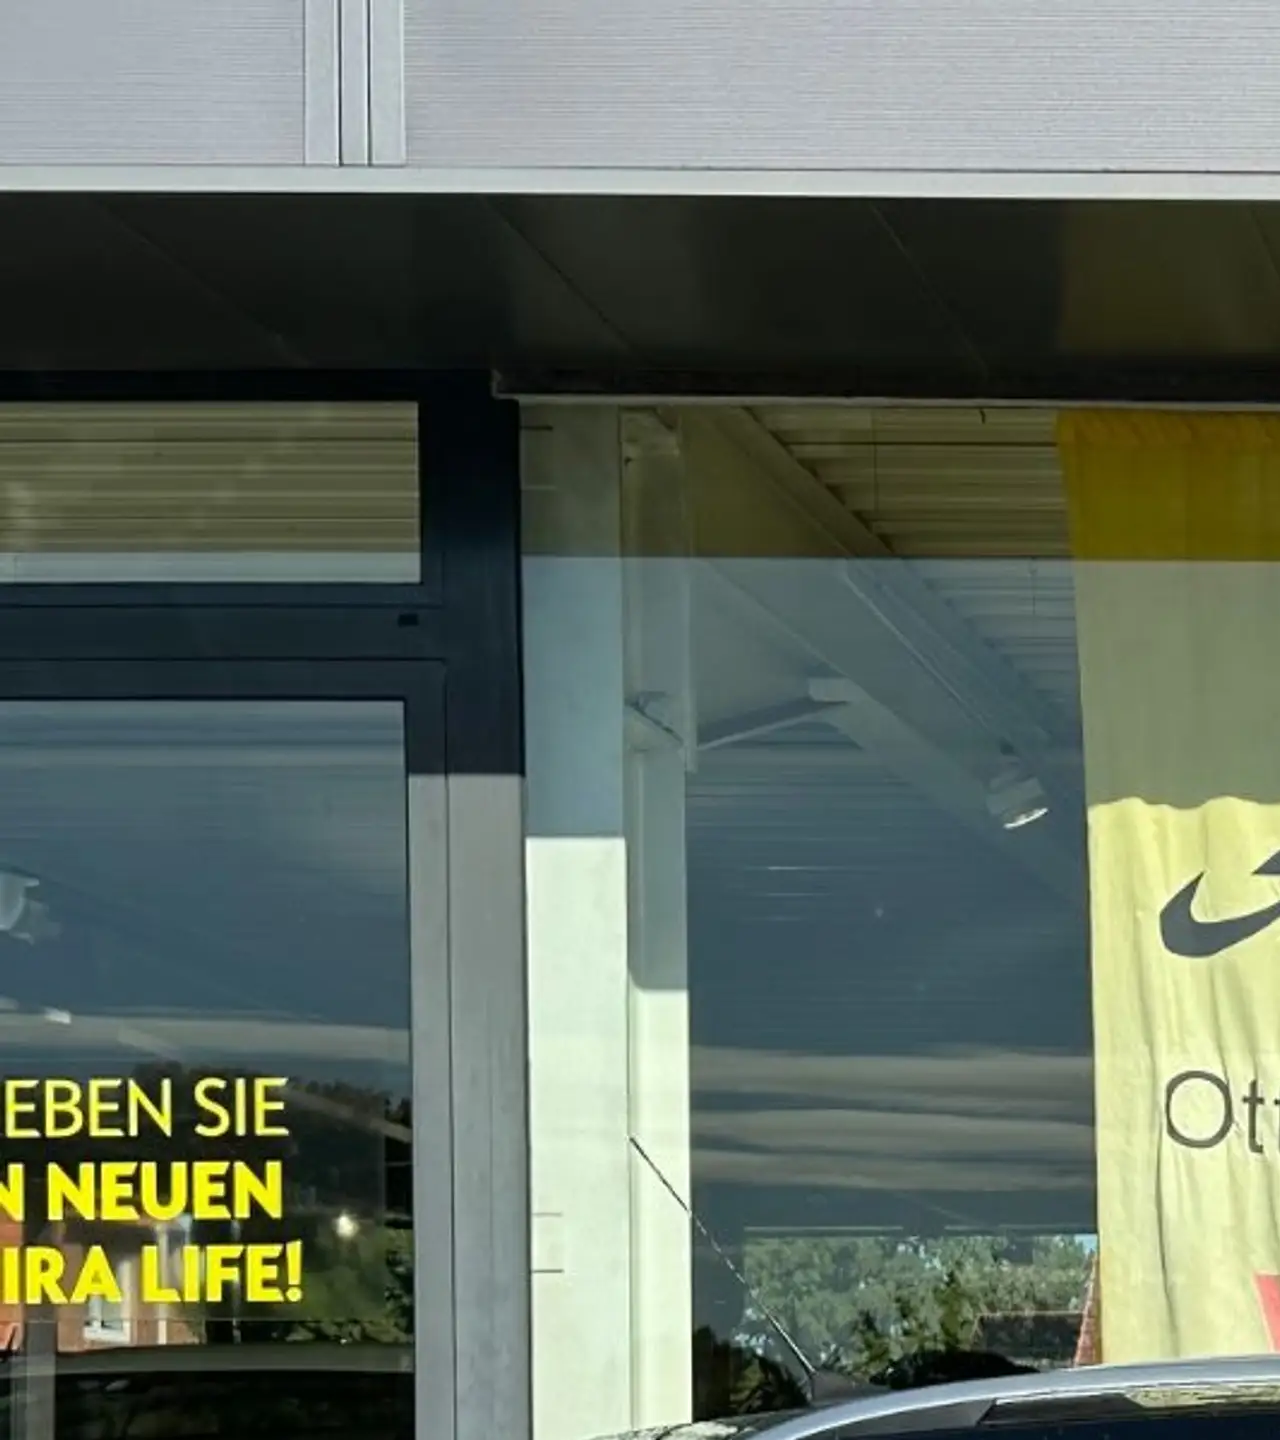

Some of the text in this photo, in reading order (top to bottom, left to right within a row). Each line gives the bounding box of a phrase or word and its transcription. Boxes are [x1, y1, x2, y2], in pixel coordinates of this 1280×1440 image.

[5, 1077, 289, 1138] EBEN SIE
[47, 1161, 283, 1221] NEUEN
[2, 1240, 302, 1304] IRA LIFE!
